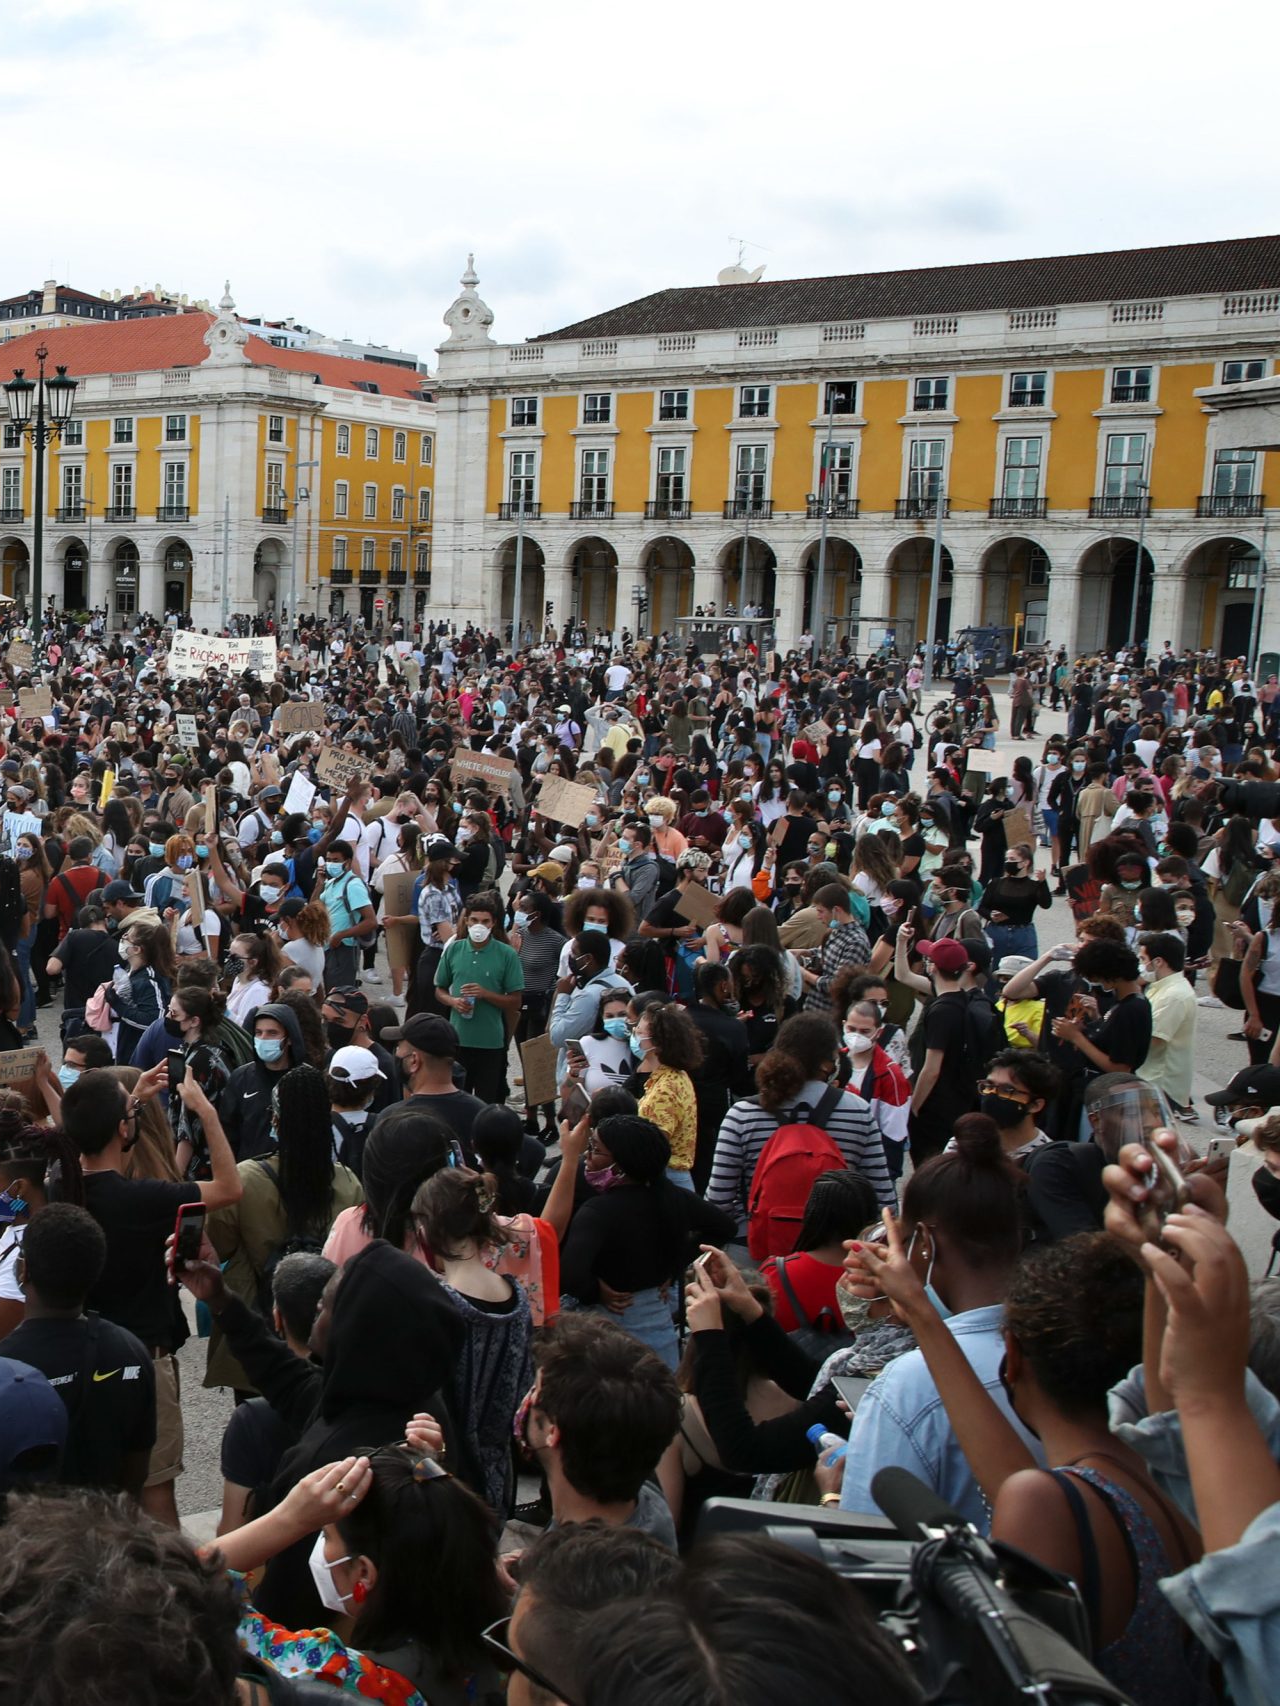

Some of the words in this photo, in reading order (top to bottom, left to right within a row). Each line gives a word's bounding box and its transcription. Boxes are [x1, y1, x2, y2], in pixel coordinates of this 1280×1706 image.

[329, 749, 346, 761] PRO
[0, 1064, 36, 1080] MATTER
[122, 1365, 141, 1380] NIKE
